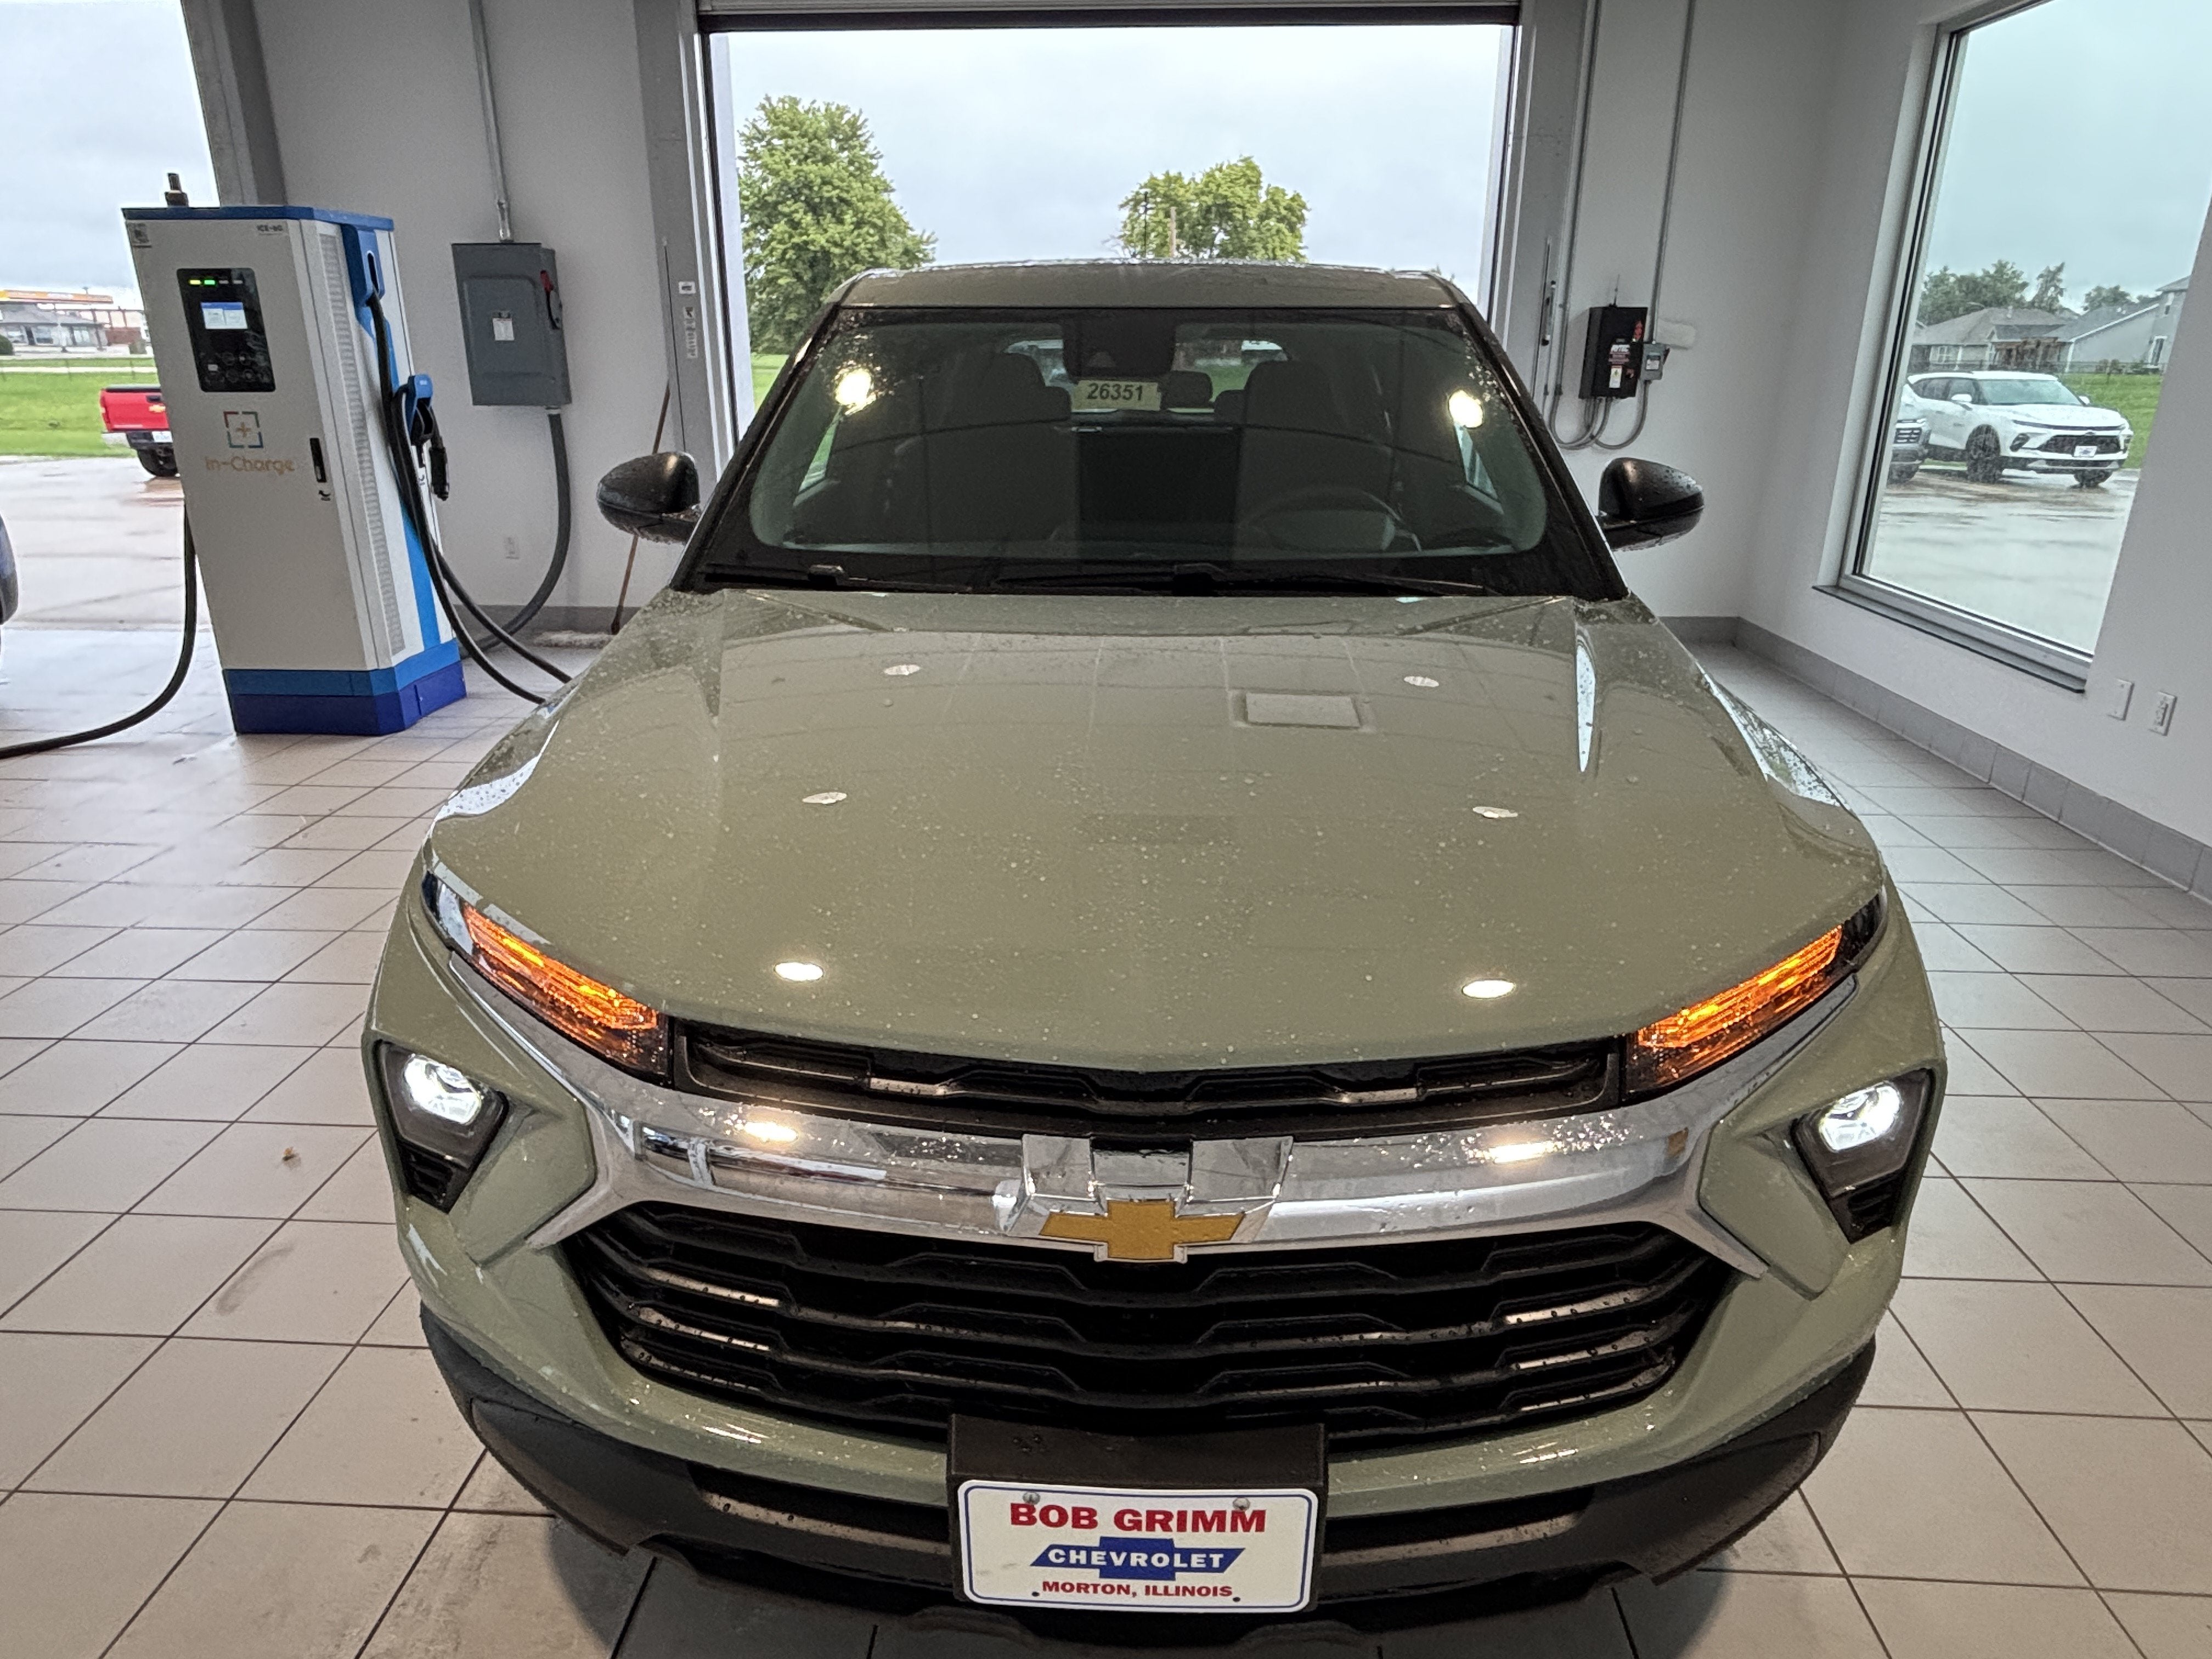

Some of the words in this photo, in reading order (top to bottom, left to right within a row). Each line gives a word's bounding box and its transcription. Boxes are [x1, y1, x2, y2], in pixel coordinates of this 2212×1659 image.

[1087, 383, 1143, 400] 26351
[205, 456, 295, 475] In-Charge
[1011, 1503, 1098, 1529] BOB
[1114, 1509, 1266, 1532] GRIMM
[1048, 1549, 1224, 1568] CHEVROLET
[1042, 1581, 1137, 1598] MORTON,
[1145, 1585, 1232, 1596] ILLINOIS
